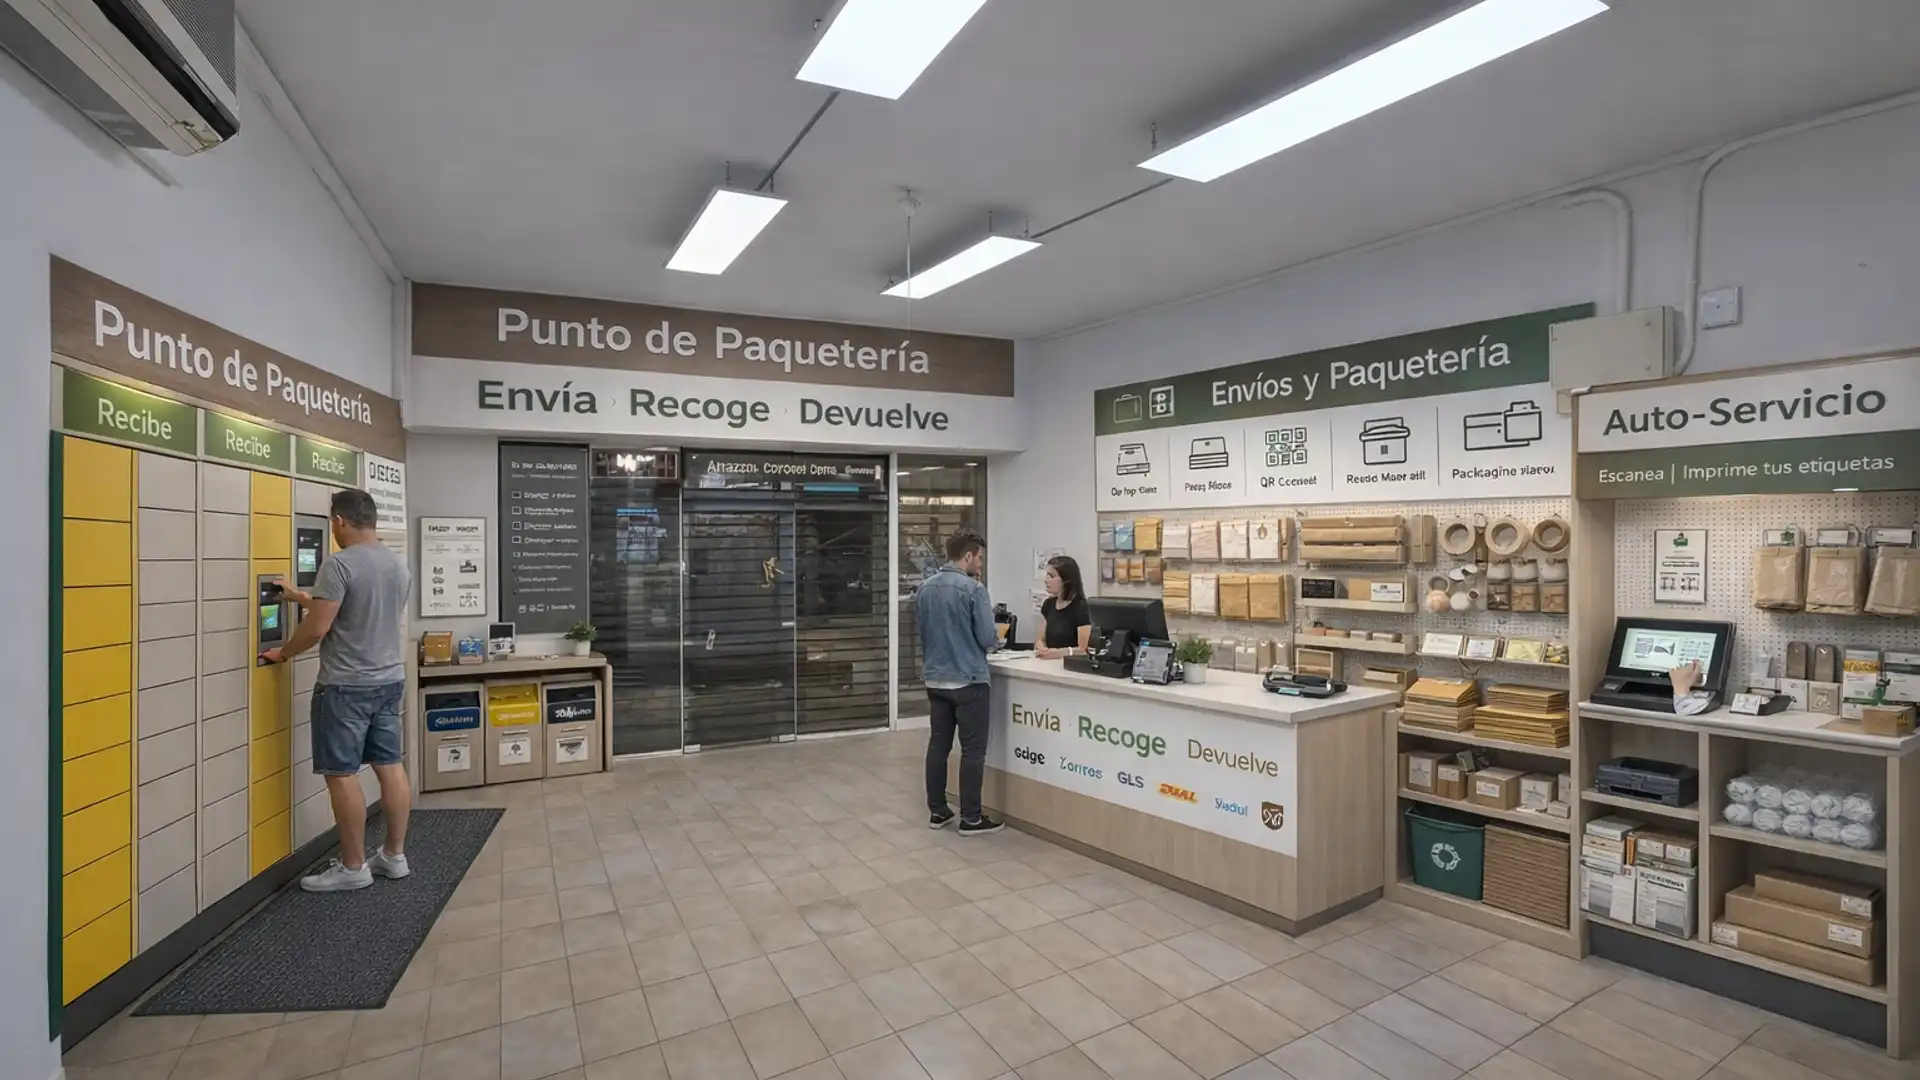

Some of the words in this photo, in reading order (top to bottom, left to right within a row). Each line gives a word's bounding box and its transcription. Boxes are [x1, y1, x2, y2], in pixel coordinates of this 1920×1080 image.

[94, 300, 214, 379] Punto
[223, 349, 258, 391] de
[266, 361, 371, 426] Paquetería
[497, 307, 632, 351] Punto
[645, 321, 697, 356] de
[715, 326, 930, 375] Paquetería
[1212, 371, 1293, 407] Envíos
[1302, 373, 1319, 400] y
[1329, 335, 1511, 391] Paquetería
[98, 398, 172, 440] Recibe
[478, 380, 598, 415] Envía
[629, 388, 770, 429] Recoge
[799, 398, 949, 432] Devuelve
[1602, 383, 1886, 436] Auto-Servicio
[225, 428, 271, 459] Recibe
[1598, 465, 1664, 483] Escanea
[1683, 462, 1757, 481] Imprime
[1763, 461, 1792, 474] tus
[1798, 456, 1894, 476] etiquetas
[1260, 476, 1275, 488] QR
[1012, 703, 1061, 732] Envía
[1078, 715, 1166, 757] Recoge
[1188, 739, 1279, 777] Devuelve
[1117, 771, 1144, 789] GLS
